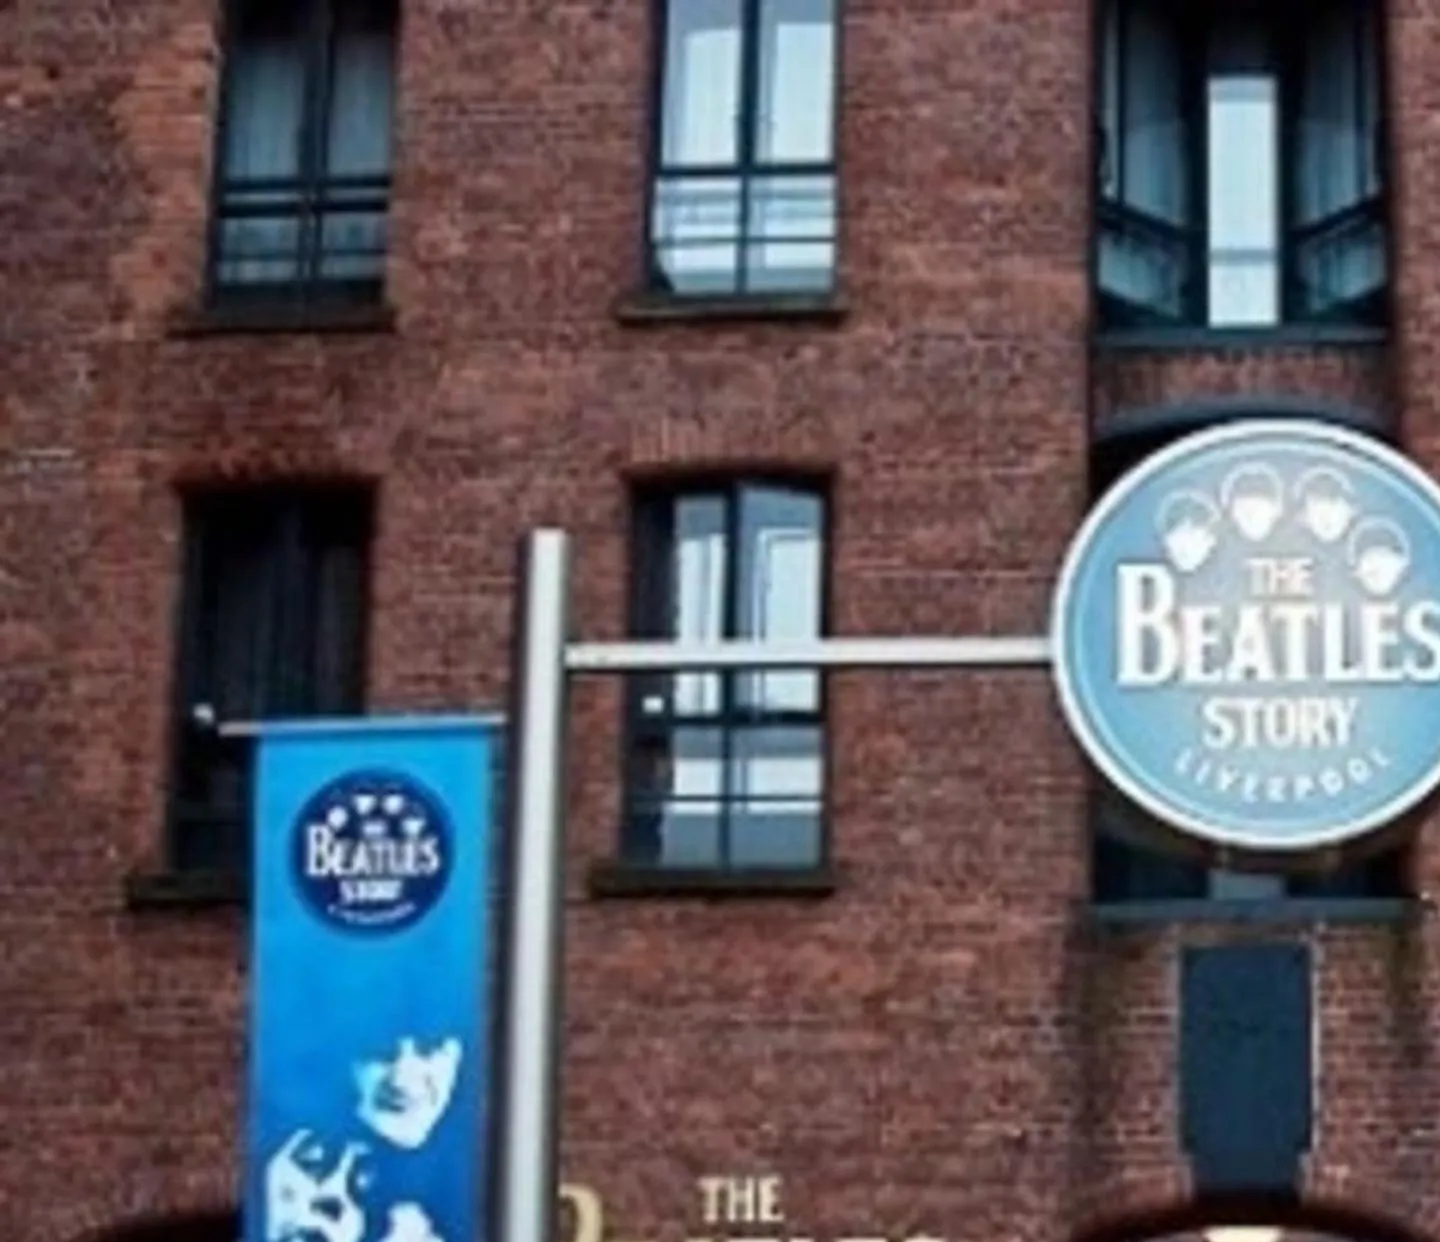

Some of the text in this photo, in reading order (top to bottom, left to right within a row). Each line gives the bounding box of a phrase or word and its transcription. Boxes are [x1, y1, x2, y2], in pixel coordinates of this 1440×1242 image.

[1245, 556, 1315, 597] THE
[1203, 697, 1358, 750] STORY
[1173, 747, 1394, 802] LIVERPOOL
[306, 822, 441, 879] BEATLES
[698, 1176, 785, 1224] THE
